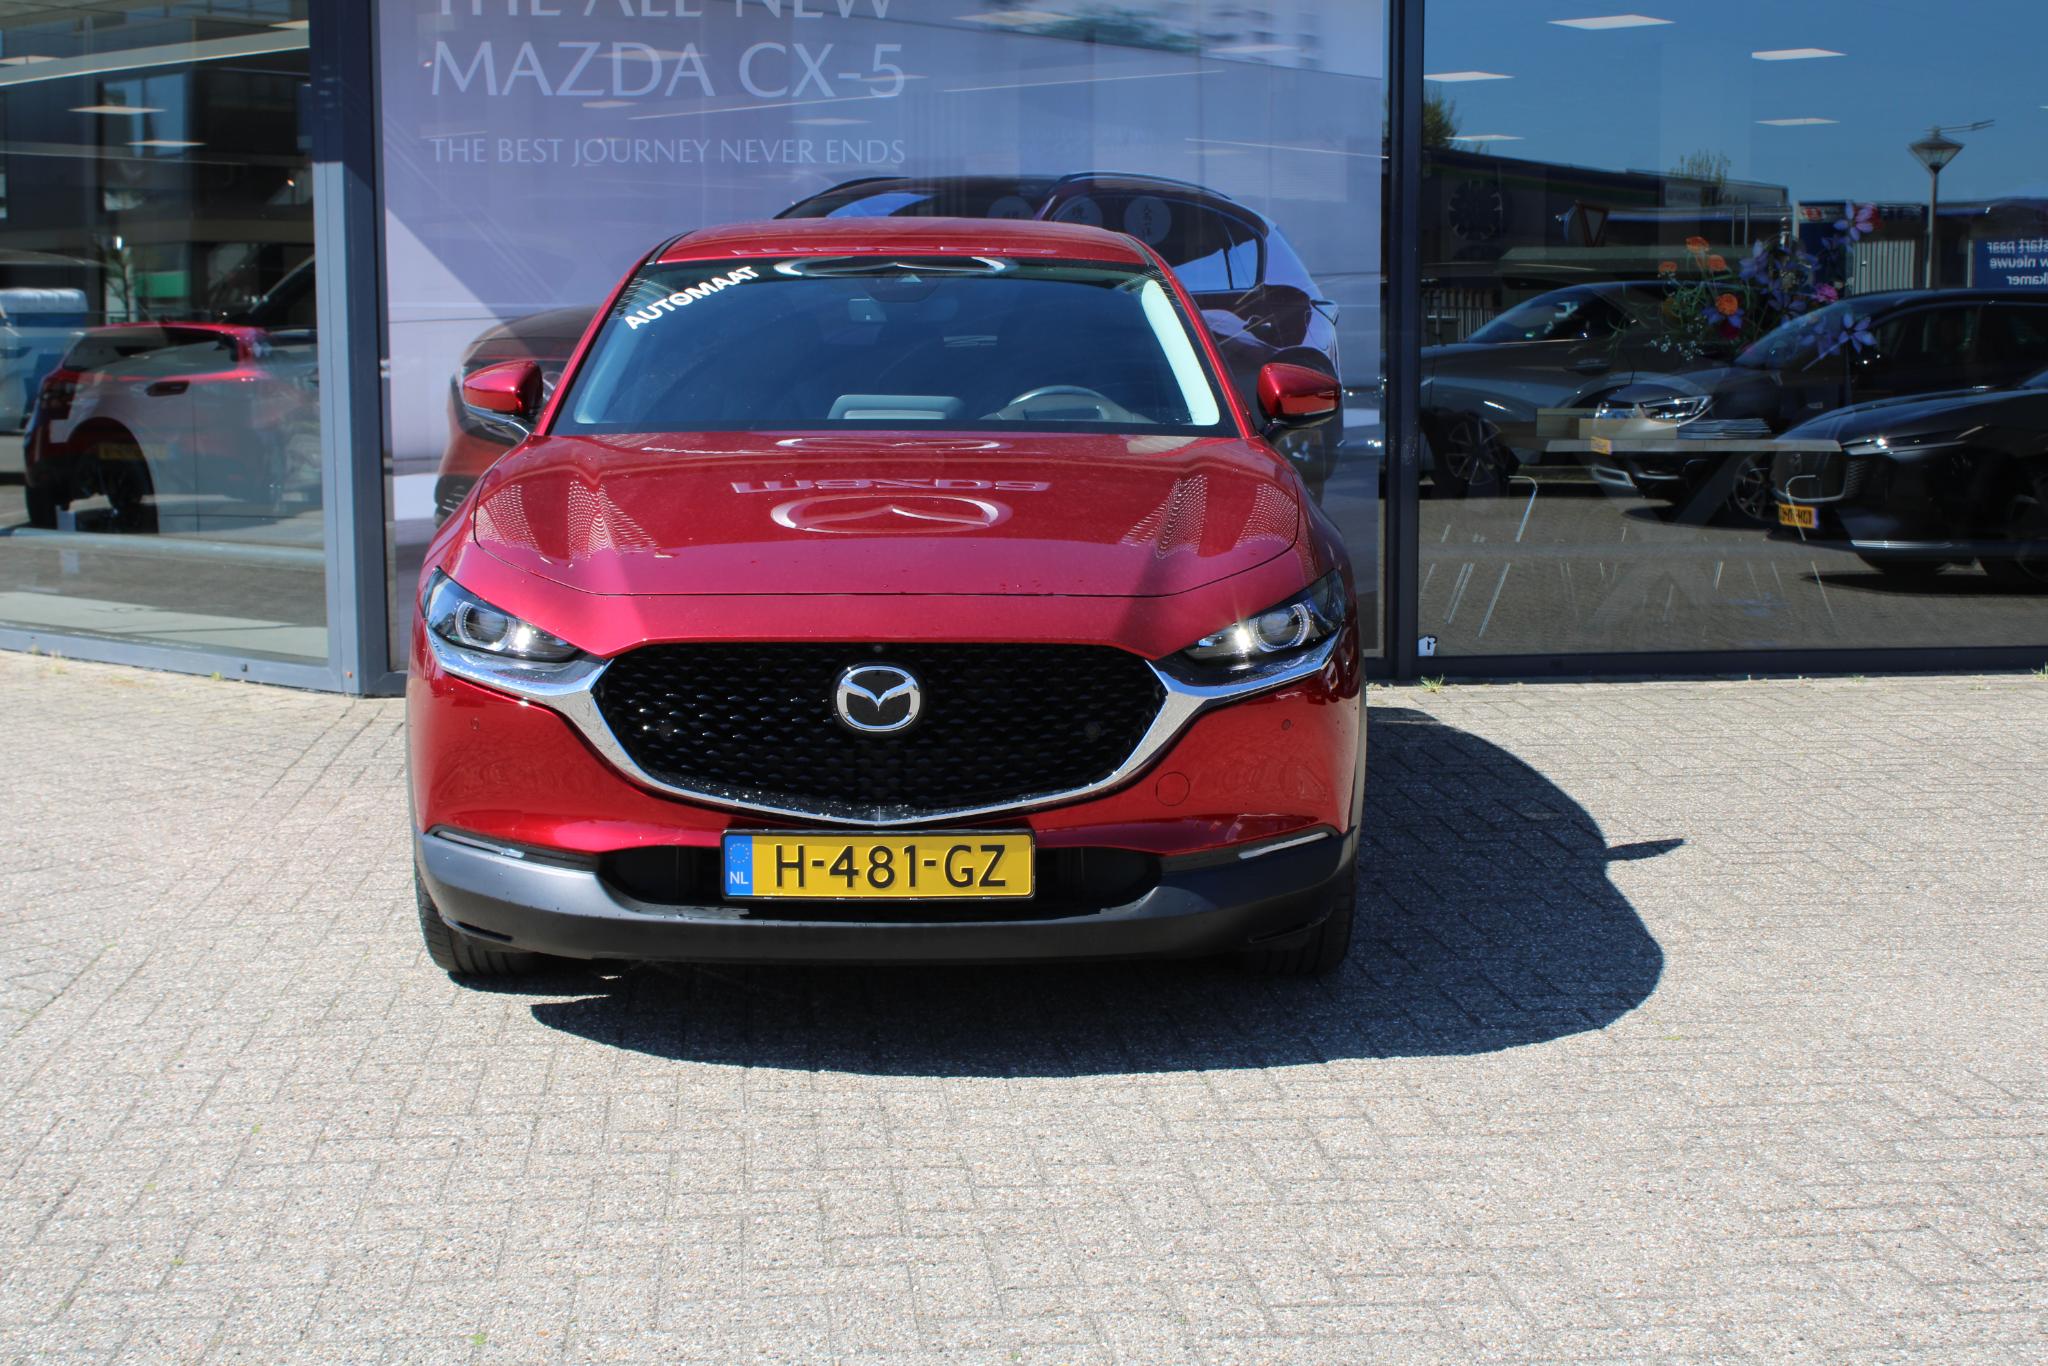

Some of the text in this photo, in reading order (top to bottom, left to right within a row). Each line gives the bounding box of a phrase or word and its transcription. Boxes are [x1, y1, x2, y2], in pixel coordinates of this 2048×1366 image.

[431, 41, 905, 98] MAZDA CX-5
[429, 138, 906, 168] THE BEST JOURNEY NEVER ENDS
[624, 265, 760, 331] AUTOMAAT
[729, 871, 750, 886] NL
[774, 843, 1007, 889] H-481-GZ
